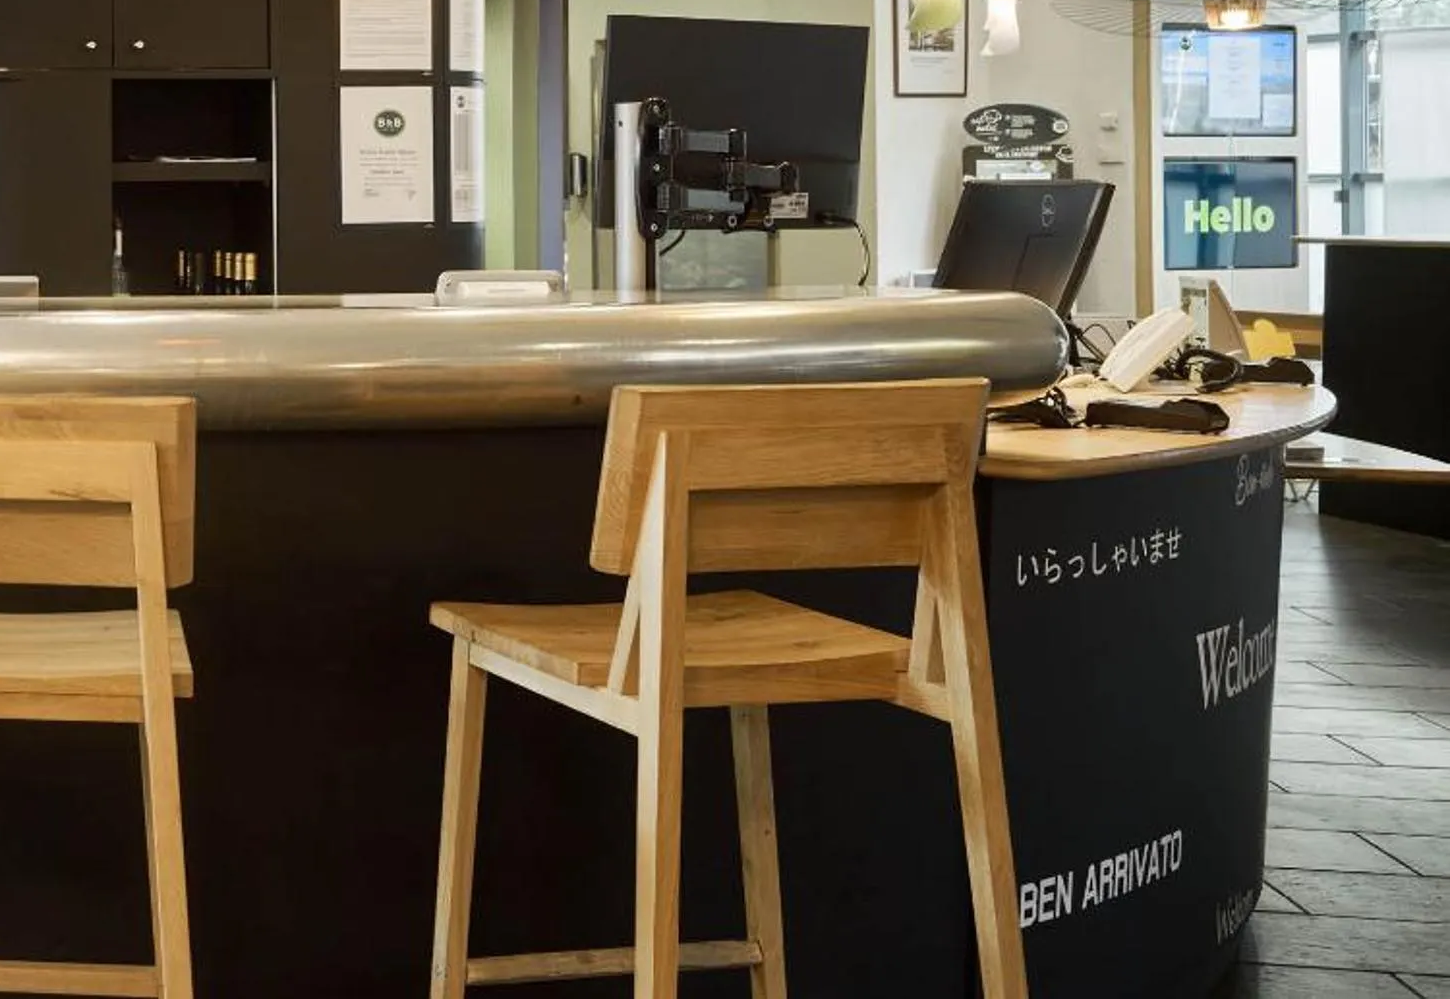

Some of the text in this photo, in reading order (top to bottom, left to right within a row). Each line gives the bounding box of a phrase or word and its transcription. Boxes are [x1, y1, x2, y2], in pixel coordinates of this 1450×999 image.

[1184, 197, 1275, 234] Hello
[1017, 526, 1182, 586] いらっしゃいませ
[1019, 829, 1183, 929] BEN ARRIVATO
